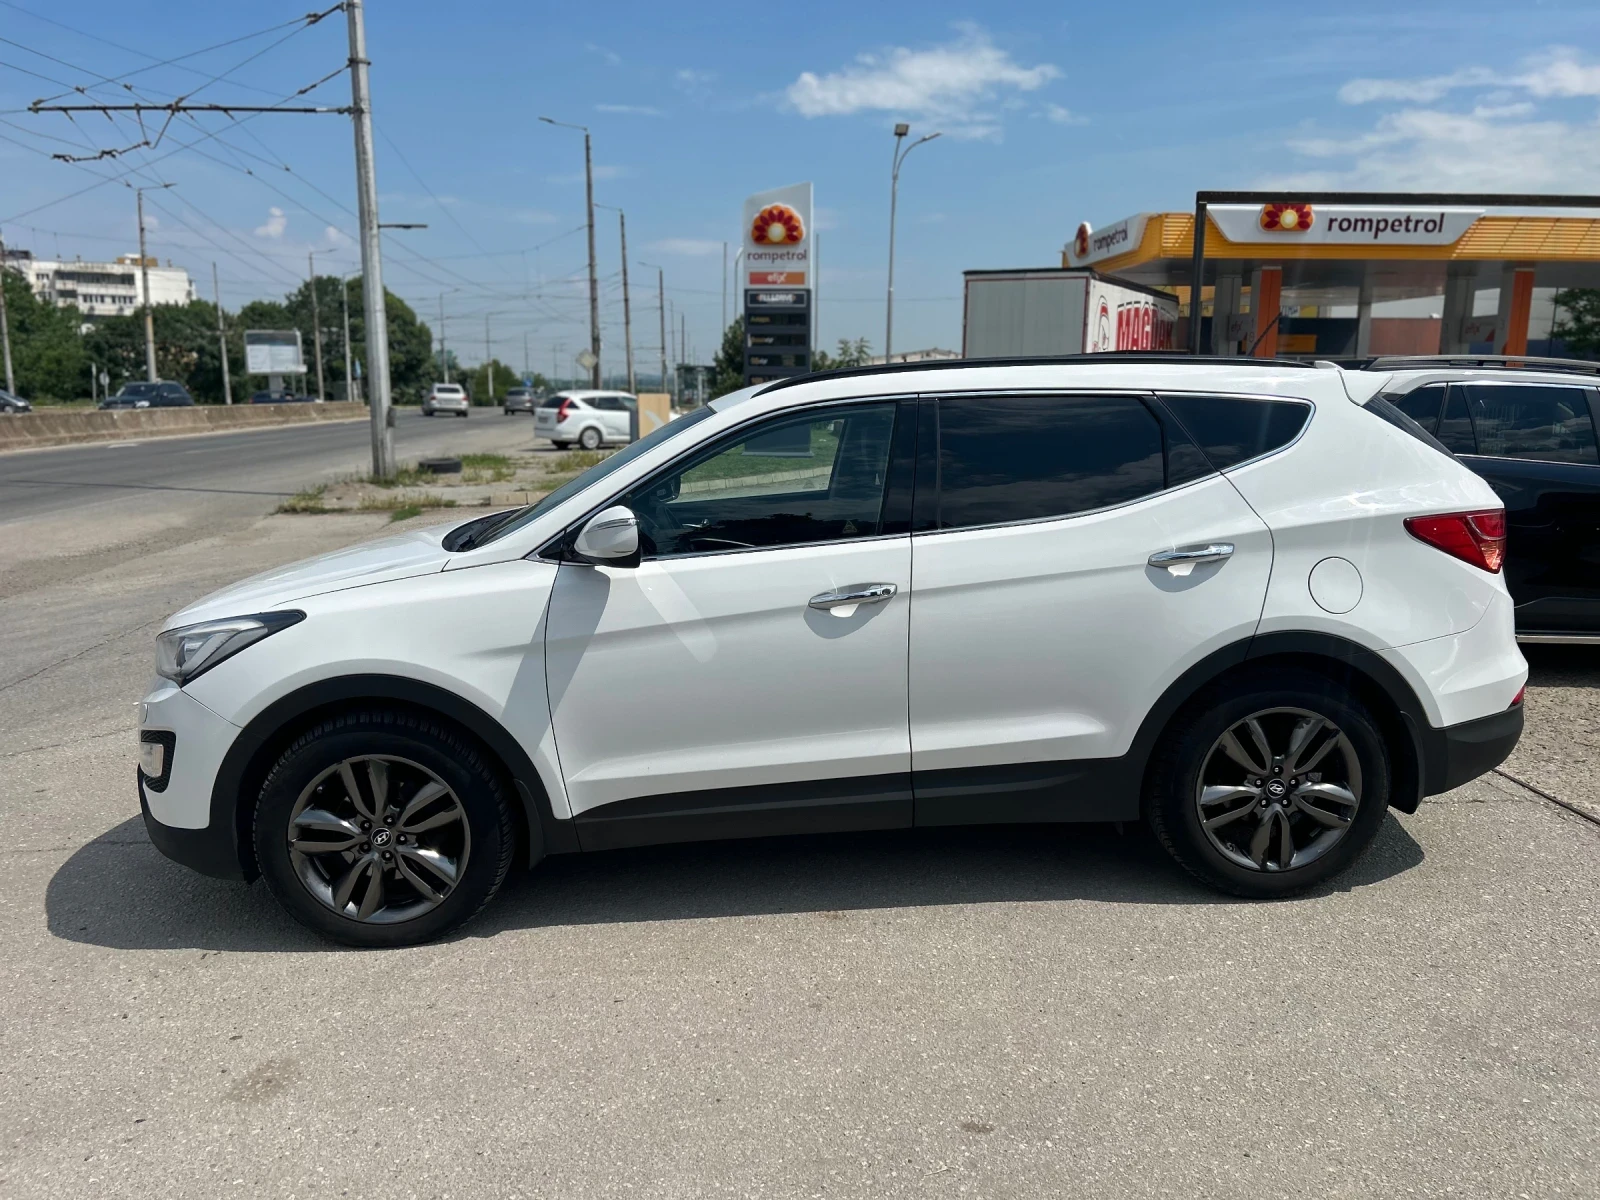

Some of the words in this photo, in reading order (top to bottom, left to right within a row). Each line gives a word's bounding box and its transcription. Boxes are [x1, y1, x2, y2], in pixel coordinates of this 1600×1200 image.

[1093, 220, 1128, 254] rompetrol
[1327, 212, 1444, 239] rompetrol
[747, 249, 807, 264] rompetrol
